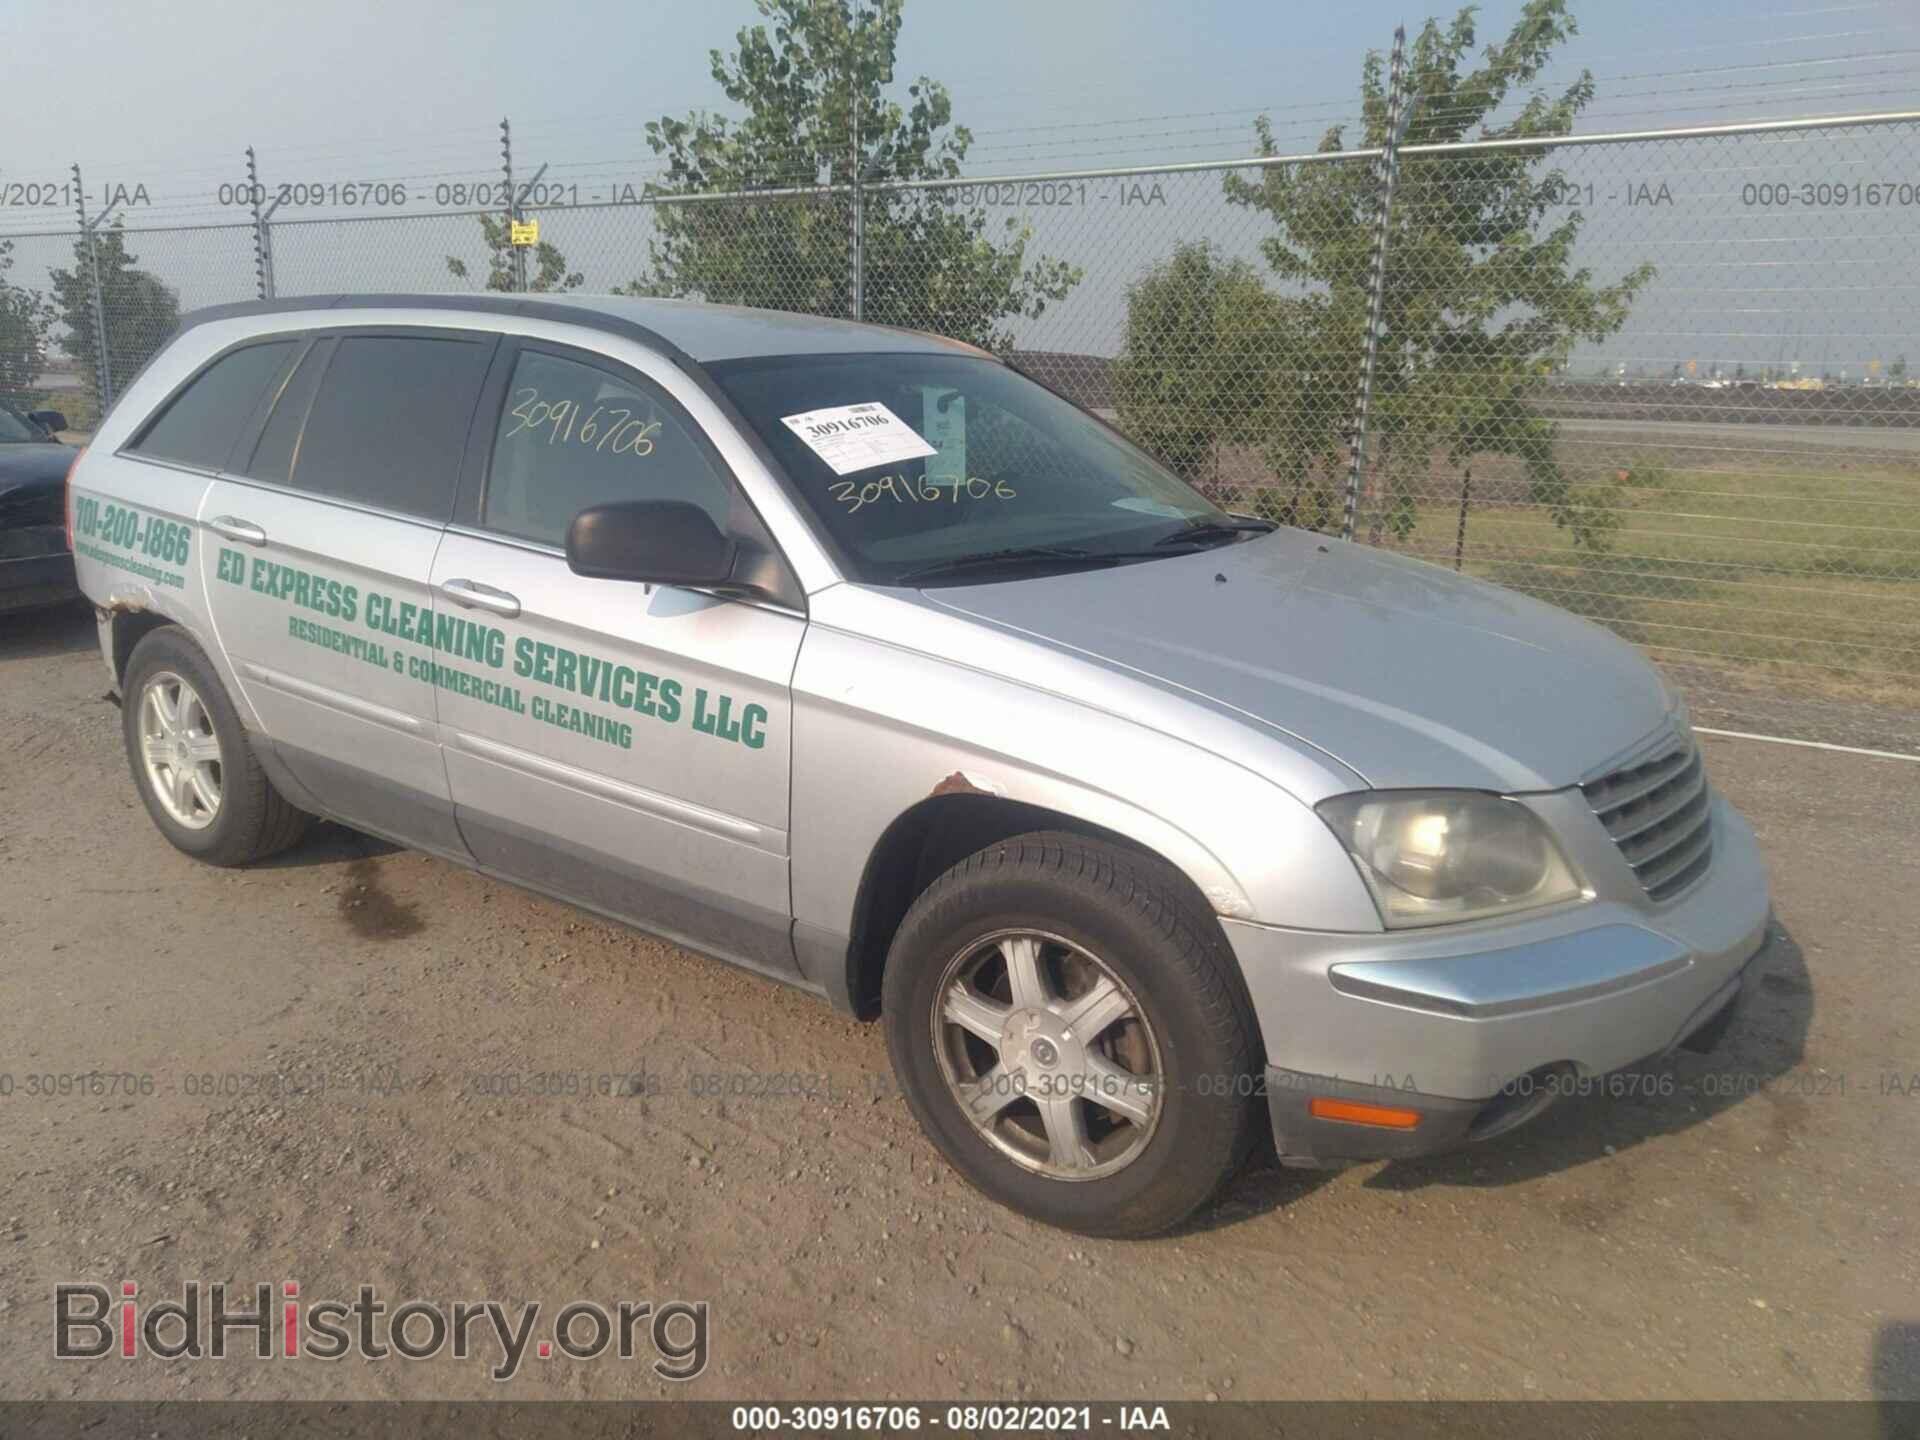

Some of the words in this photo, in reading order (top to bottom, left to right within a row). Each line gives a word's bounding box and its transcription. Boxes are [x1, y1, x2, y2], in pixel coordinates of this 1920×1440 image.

[505, 387, 662, 456] 30916706
[805, 414, 890, 439] 30916706
[827, 473, 1017, 513] 30916706
[76, 495, 191, 566] 701-200-1866
[216, 547, 246, 587] ED
[251, 557, 359, 622] EXPRESS
[365, 592, 505, 668] CLEANING
[513, 636, 684, 724] SERVICES
[692, 688, 769, 750] LLC
[288, 616, 388, 670] RESIDENTIAL
[393, 650, 405, 672] &
[408, 655, 526, 715] COMMERCIAL
[531, 695, 633, 750] CLEANING
